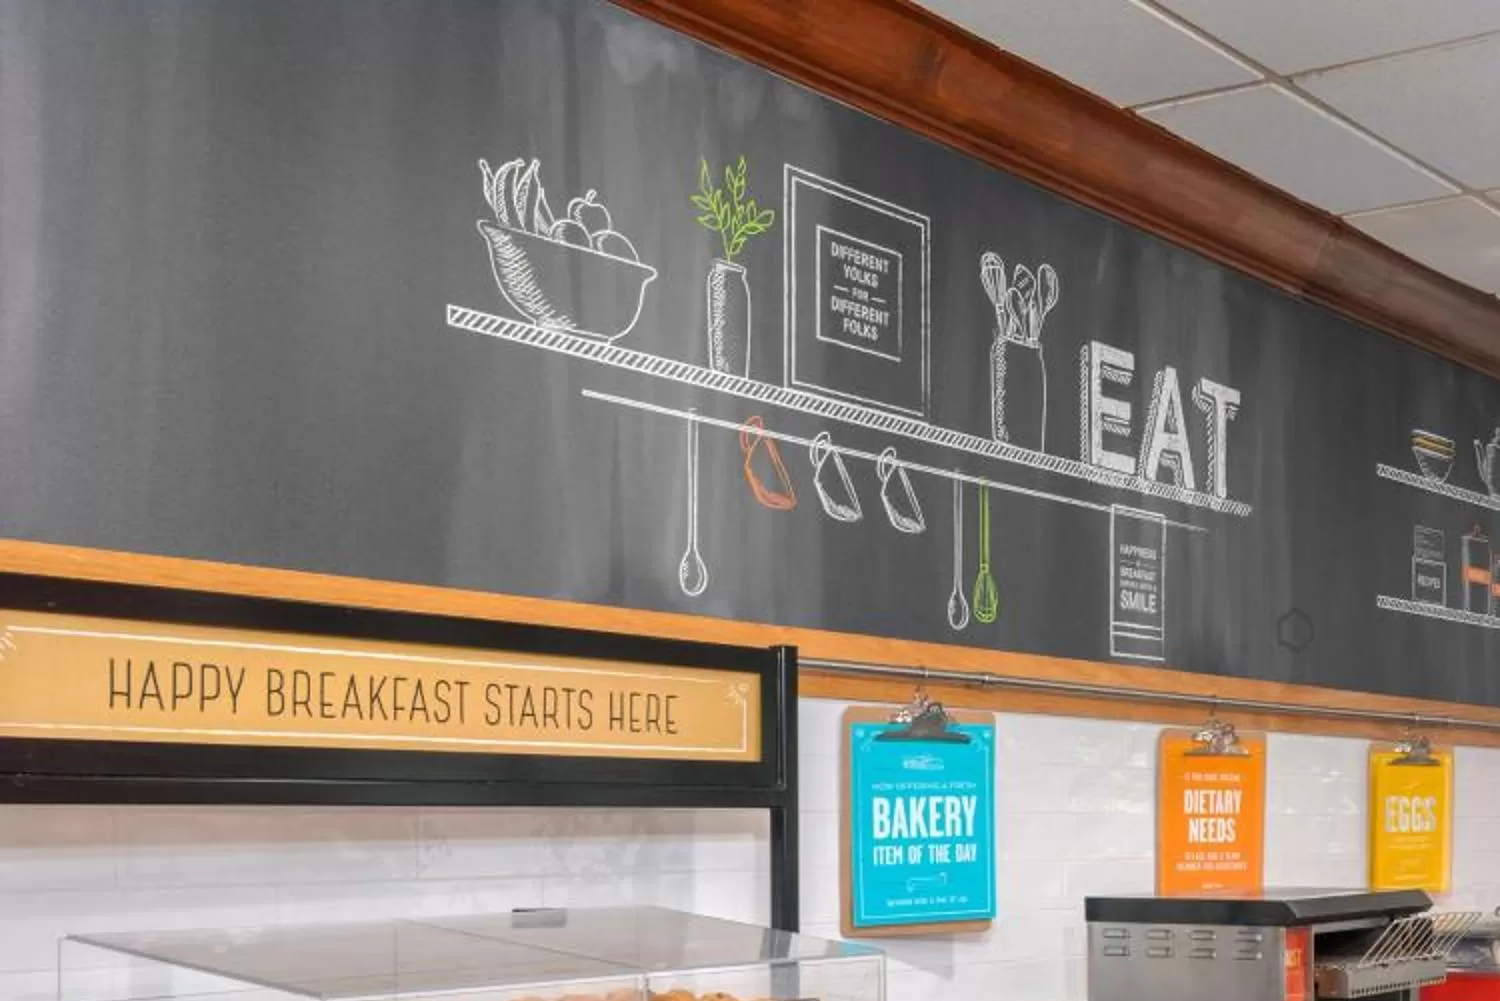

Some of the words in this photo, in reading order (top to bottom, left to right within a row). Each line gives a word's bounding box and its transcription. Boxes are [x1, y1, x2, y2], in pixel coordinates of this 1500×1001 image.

[831, 241, 890, 273] DIFFERENT
[844, 263, 879, 288] YOLKS
[852, 287, 869, 301] FOR
[831, 295, 890, 327] DIFFERENT
[843, 317, 879, 341] FOLKS
[1080, 340, 1241, 499] EAT
[1119, 588, 1157, 614] SMILE
[108, 657, 246, 715] HAPPY
[266, 667, 470, 726] BREAKFAST
[484, 682, 593, 732] STARTS
[608, 690, 679, 735] HERE
[1183, 788, 1243, 815] DIETARY
[1384, 795, 1437, 832] EGGS
[872, 795, 977, 840] BAKERY
[1188, 818, 1236, 842] NEEDS
[873, 845, 903, 866] ITEM
[908, 845, 922, 865] OF
[928, 844, 951, 864] THE
[956, 843, 977, 863] DAY
